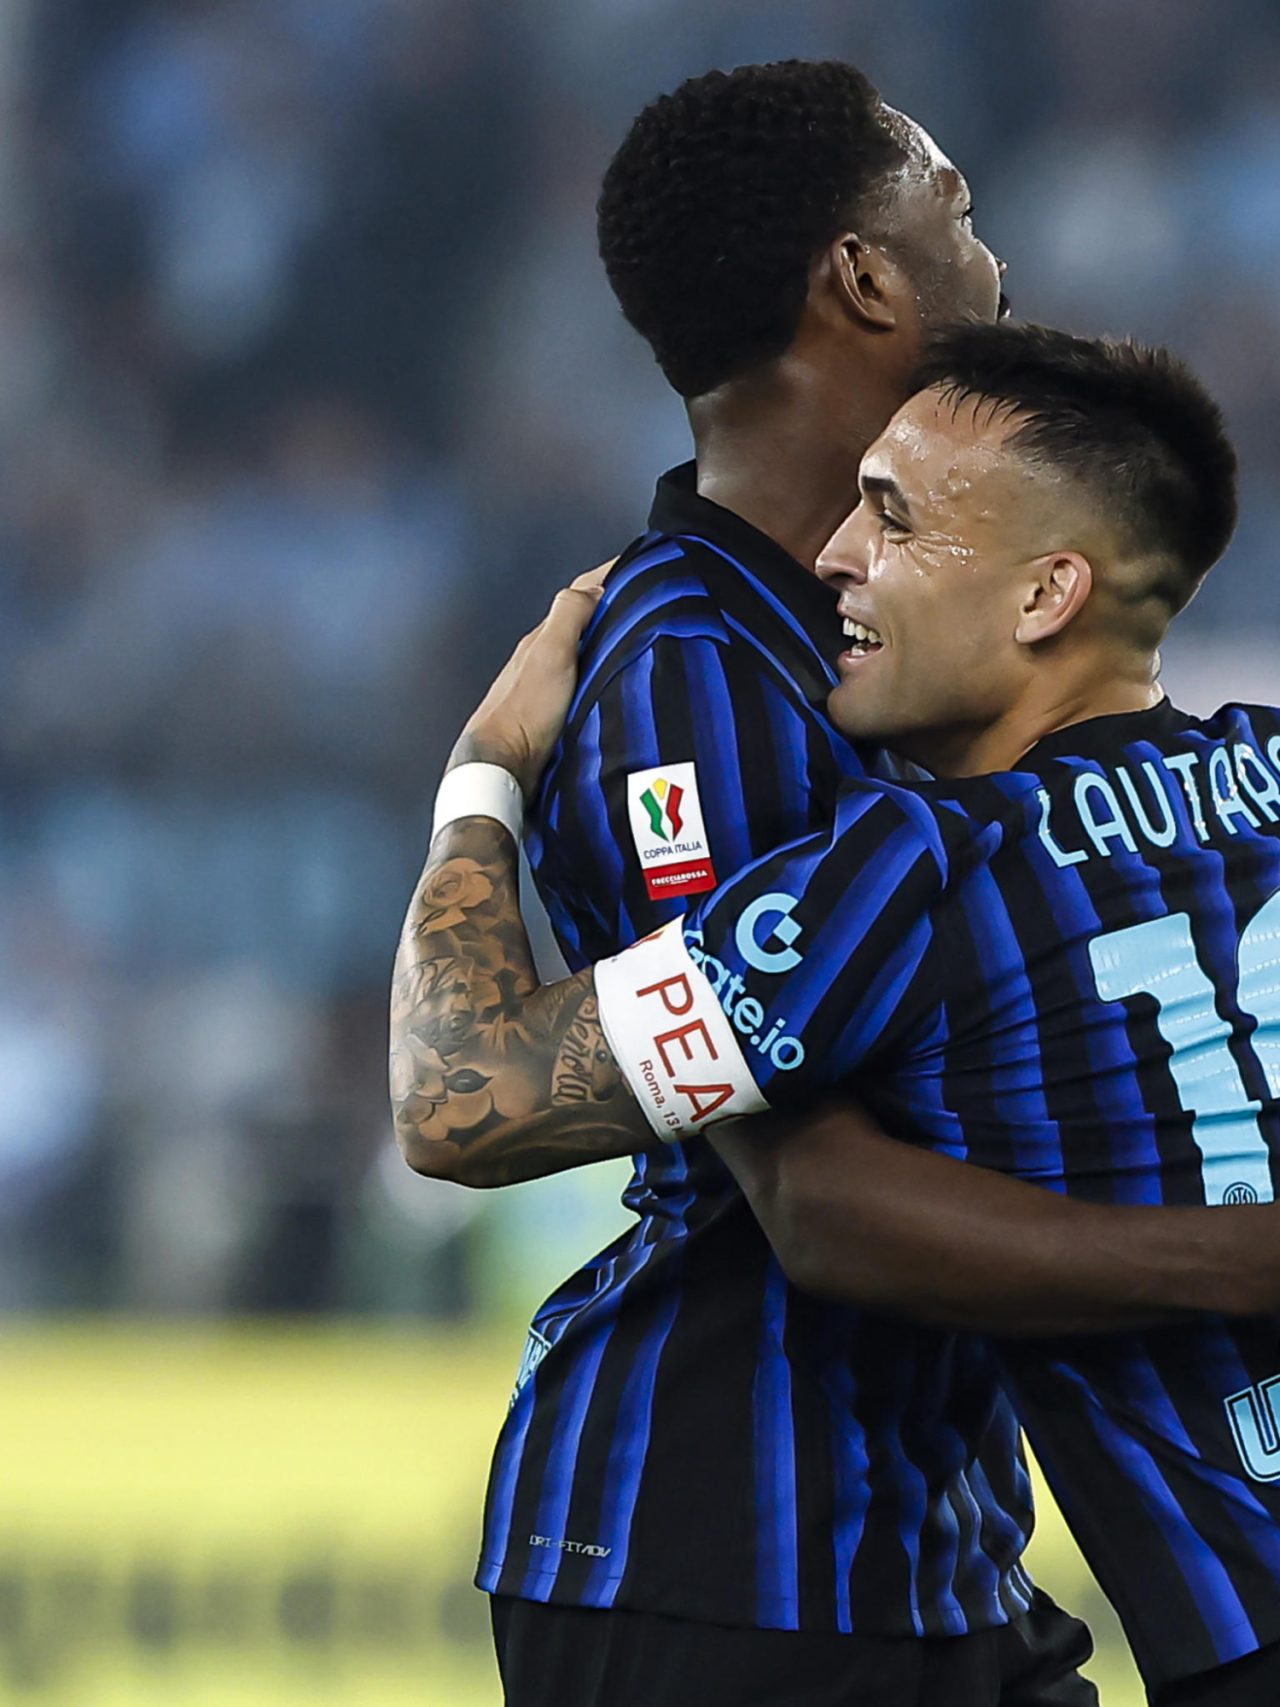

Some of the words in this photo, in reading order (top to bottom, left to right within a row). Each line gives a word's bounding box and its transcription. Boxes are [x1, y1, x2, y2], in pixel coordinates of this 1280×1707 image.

[643, 846, 673, 859] COPPA
[674, 840, 702, 853] ITALIA
[636, 972, 735, 1124] PEA
[639, 1059, 667, 1109] Roma,
